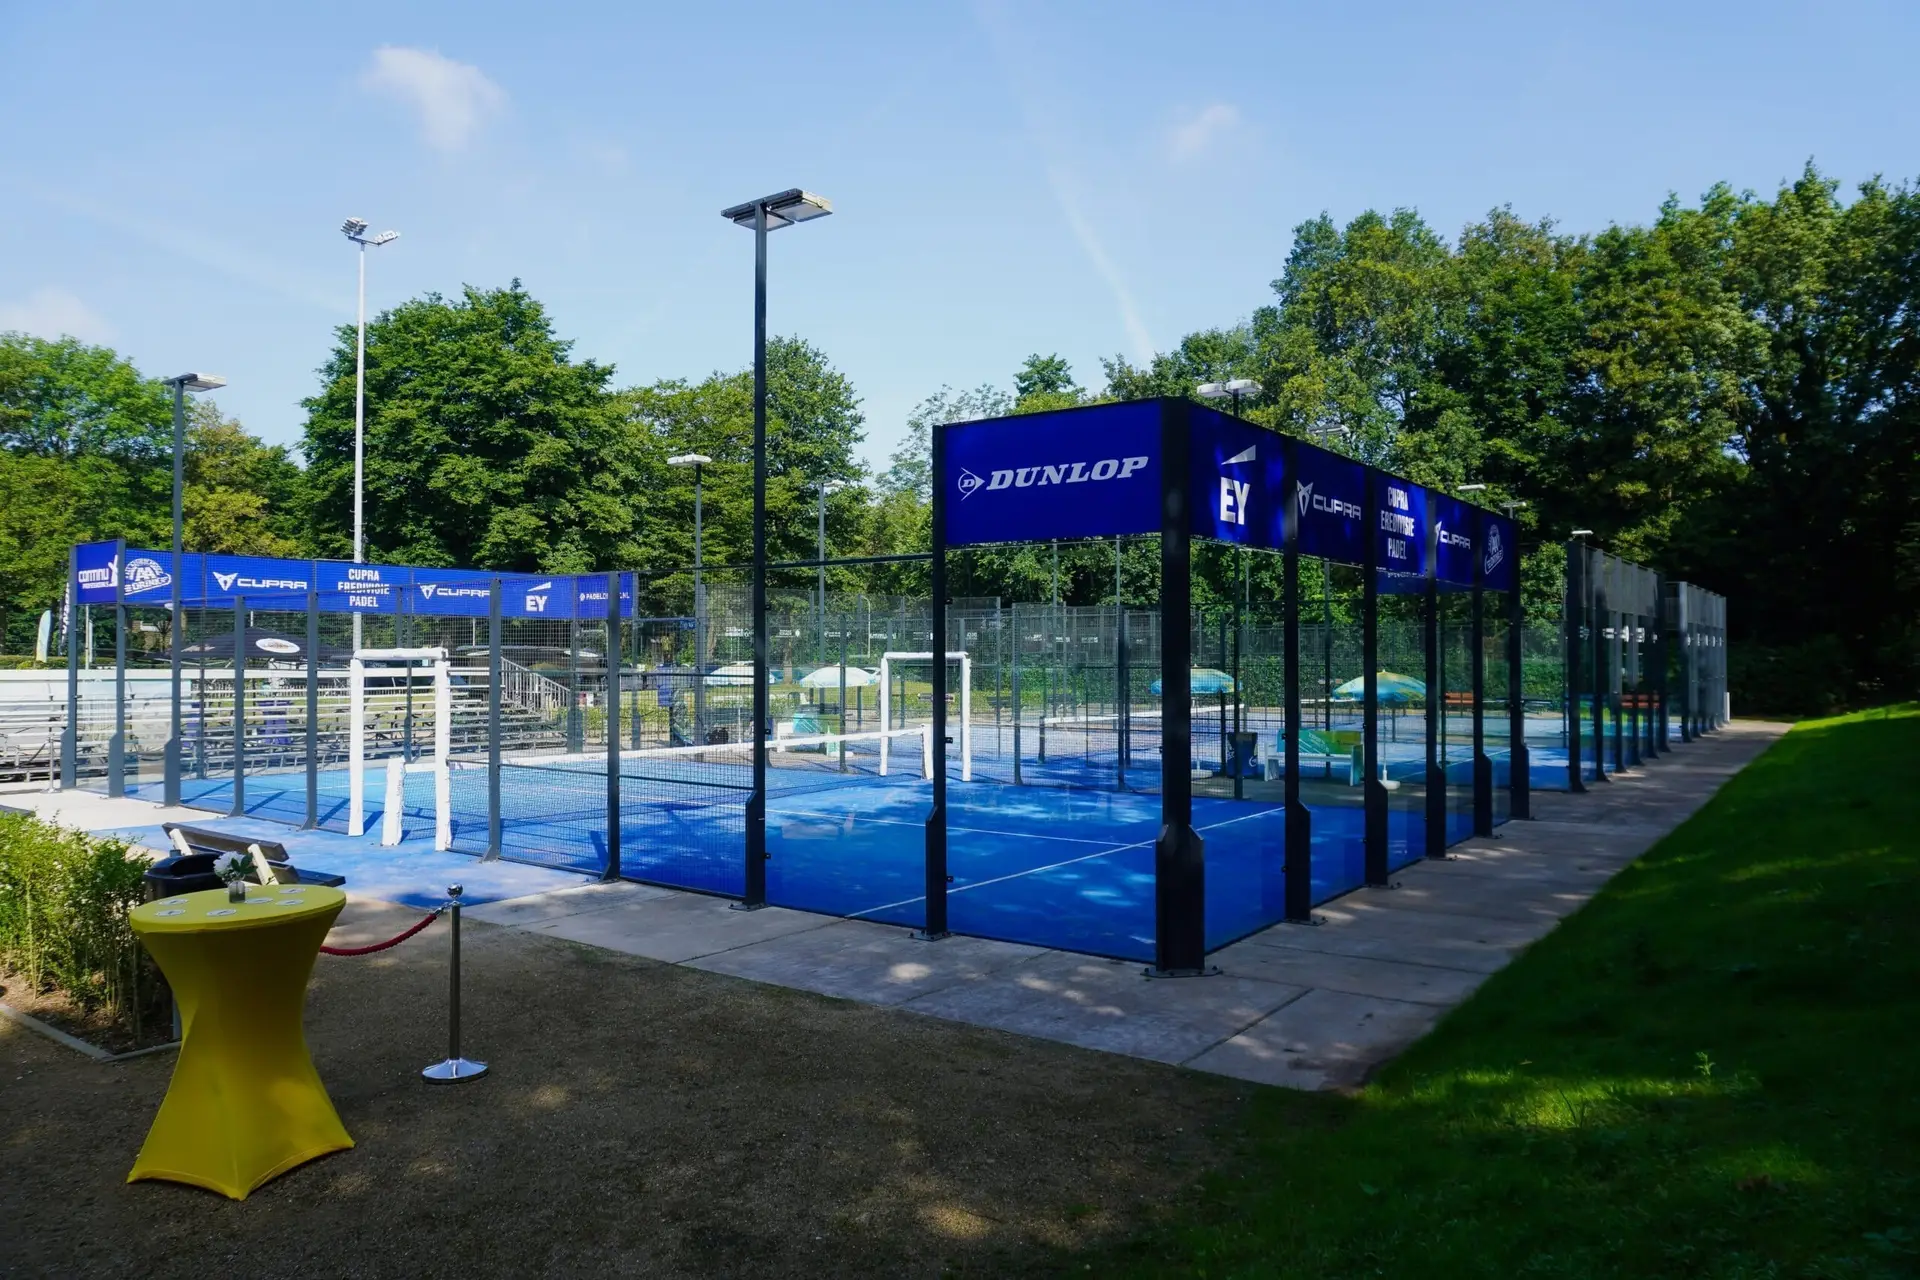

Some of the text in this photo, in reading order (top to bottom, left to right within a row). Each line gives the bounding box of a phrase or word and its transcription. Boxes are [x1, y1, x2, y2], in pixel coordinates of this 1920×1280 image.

[985, 456, 1149, 491] DUNLOP
[1220, 476, 1250, 525] EY
[1312, 494, 1361, 521] CUPRA
[1387, 486, 1409, 511] CUPRA
[1388, 538, 1407, 560] PADEL
[1440, 530, 1471, 550] CUPRA
[237, 578, 308, 590] CUPRA
[348, 568, 380, 581] CUPRA
[349, 595, 379, 607] PADEL
[526, 595, 548, 612] EY
